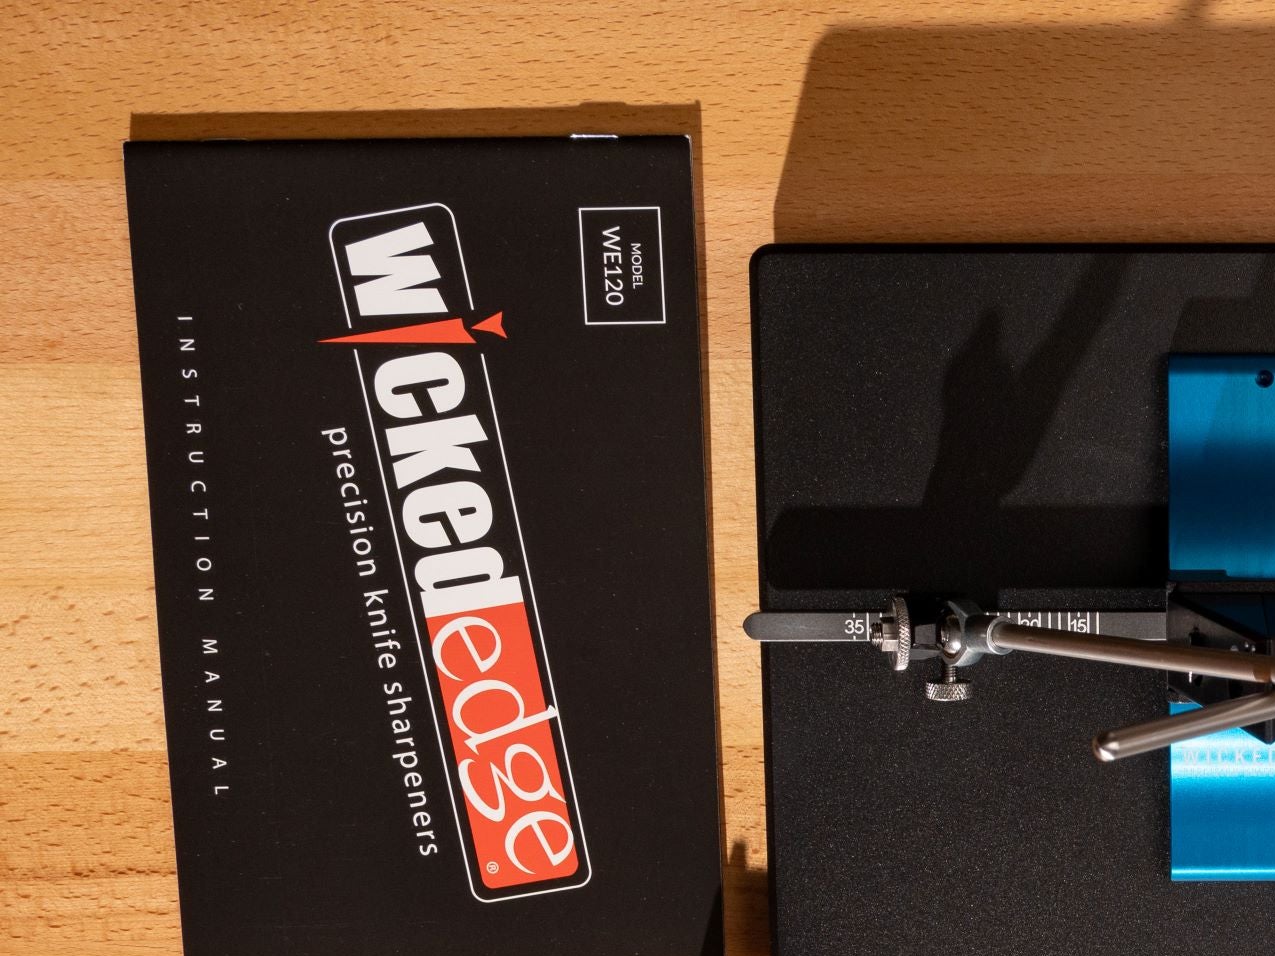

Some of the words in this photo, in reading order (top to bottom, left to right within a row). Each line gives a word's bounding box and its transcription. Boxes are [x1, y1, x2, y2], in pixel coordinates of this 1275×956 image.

[602, 225, 624, 306] WE120
[630, 242, 644, 290] MODEL
[177, 316, 214, 601] INSTRUCTION
[202, 639, 229, 795] MANUAL
[321, 427, 377, 577] precision
[363, 588, 401, 669] knife
[383, 681, 438, 857] sharpeners
[844, 619, 865, 634] 35
[1070, 619, 1087, 633] 15
